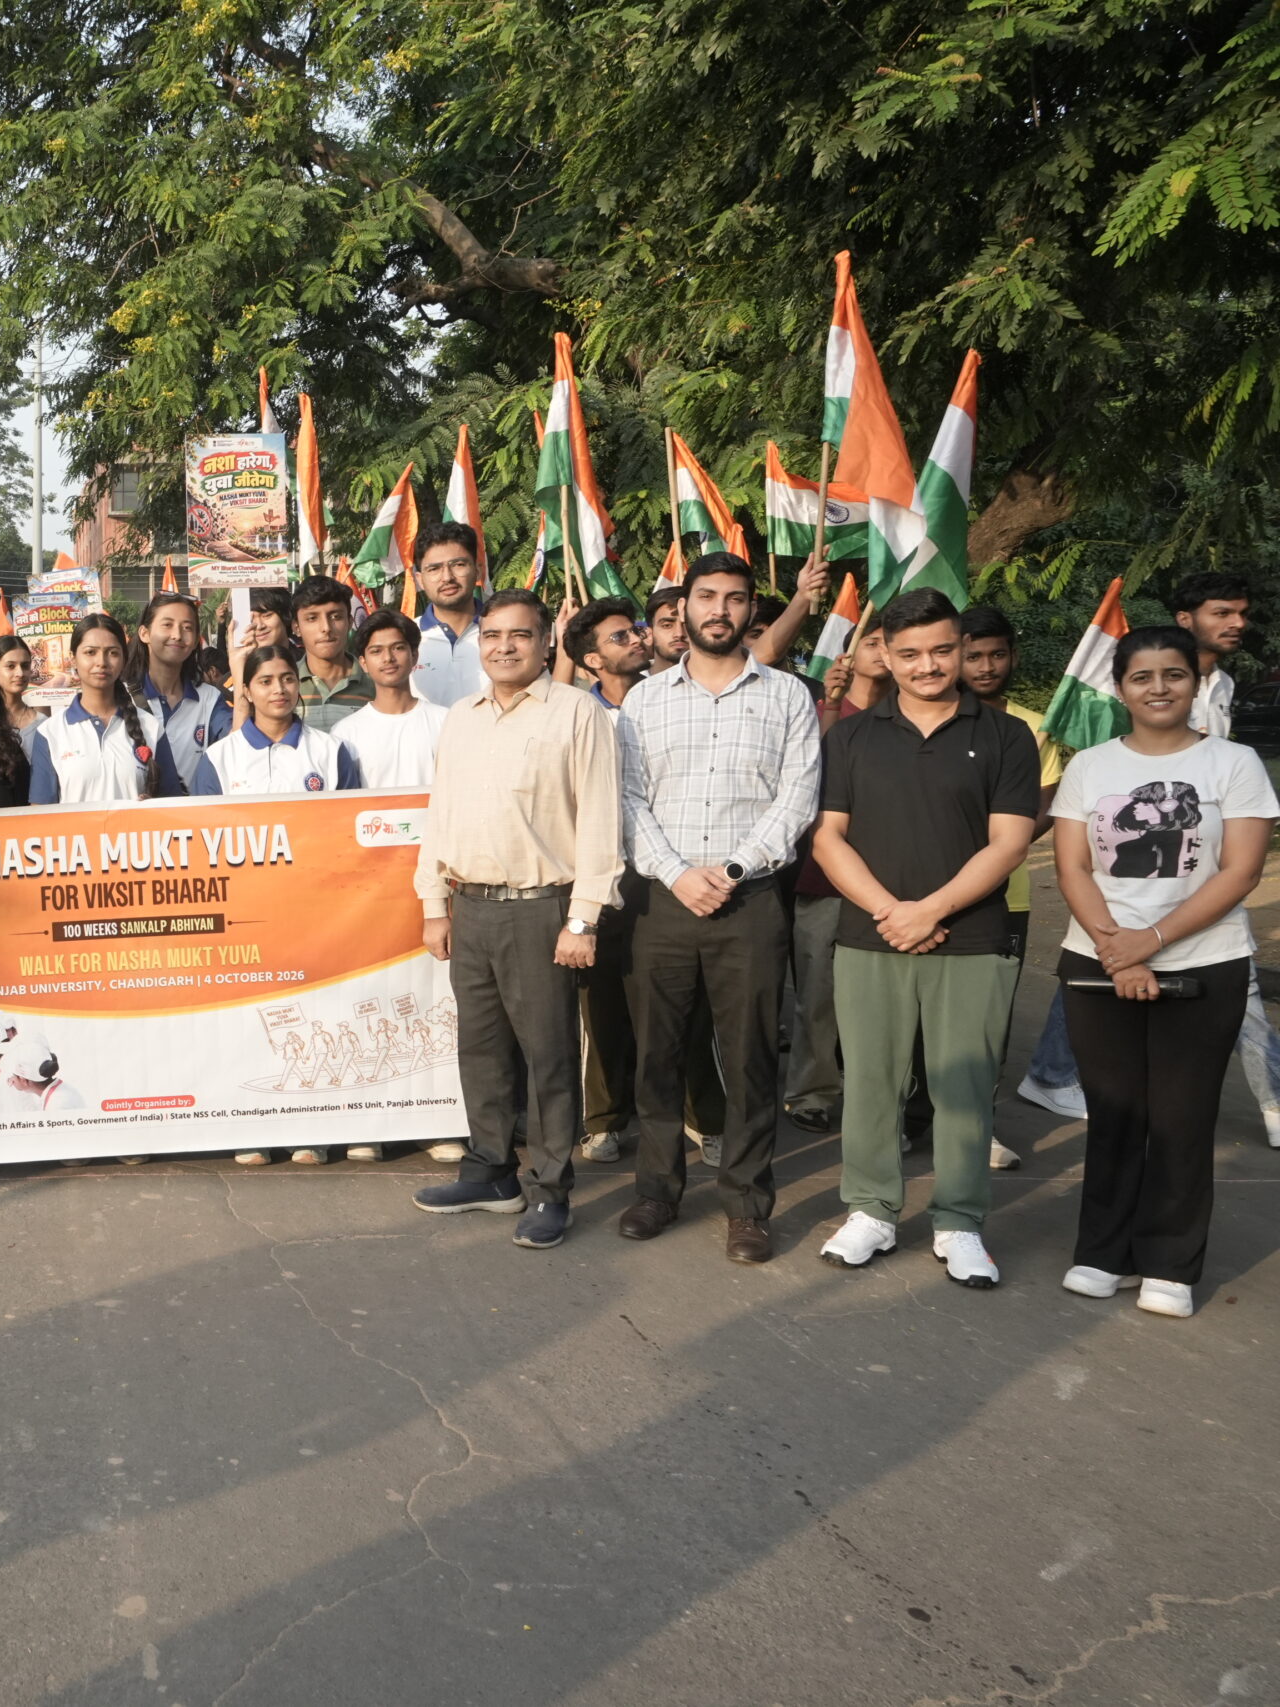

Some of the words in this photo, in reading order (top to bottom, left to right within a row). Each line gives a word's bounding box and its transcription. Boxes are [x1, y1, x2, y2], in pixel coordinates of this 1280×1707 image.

[204, 455, 235, 473] नशा
[237, 452, 272, 470] हारेगा,
[204, 475, 233, 495] युवा
[234, 471, 274, 488] जीतेगा
[40, 606, 69, 621] Block
[43, 621, 74, 634] Unlock
[1096, 814, 1109, 852] GLAM
[100, 829, 193, 872] MUKT
[200, 824, 293, 868] YUVA
[1183, 837, 1203, 872] ドキ
[41, 885, 79, 911] FOR
[83, 880, 146, 909] VIKSIT
[152, 876, 230, 906] BHARAT
[63, 924, 81, 938] 100
[83, 922, 118, 937] WEEKS
[120, 920, 167, 935] SANKALP
[170, 918, 214, 932] ABHIYAN
[20, 954, 65, 976] WALK
[70, 952, 102, 974] FOR
[107, 949, 162, 972] NASHA
[167, 946, 214, 969] MUKT
[218, 944, 261, 966] YUVA
[30, 980, 106, 995] UNIVERSITY,
[109, 976, 194, 990] CHANDIGARH
[204, 974, 212, 986] 4
[214, 971, 273, 985] OCTOBER
[276, 969, 305, 982] 2026
[9, 1121, 36, 1130] Affairs
[38, 1120, 45, 1128] &
[46, 1119, 75, 1129] Sports,
[77, 1115, 127, 1126] Government
[129, 1114, 138, 1123] of
[139, 1112, 163, 1122] India)
[170, 1111, 191, 1120] State
[193, 1110, 209, 1118] NSS
[211, 1109, 229, 1118] Cell,
[231, 1106, 277, 1118] Chandigarh
[280, 1103, 341, 1114] Administration
[347, 1101, 363, 1110] NSS
[365, 1100, 384, 1110] Unit,
[386, 1098, 414, 1109] Panjab
[416, 1096, 458, 1107] University
[105, 1101, 132, 1110] Jointly
[134, 1098, 176, 1109] Organised
[179, 1098, 191, 1107] by:
